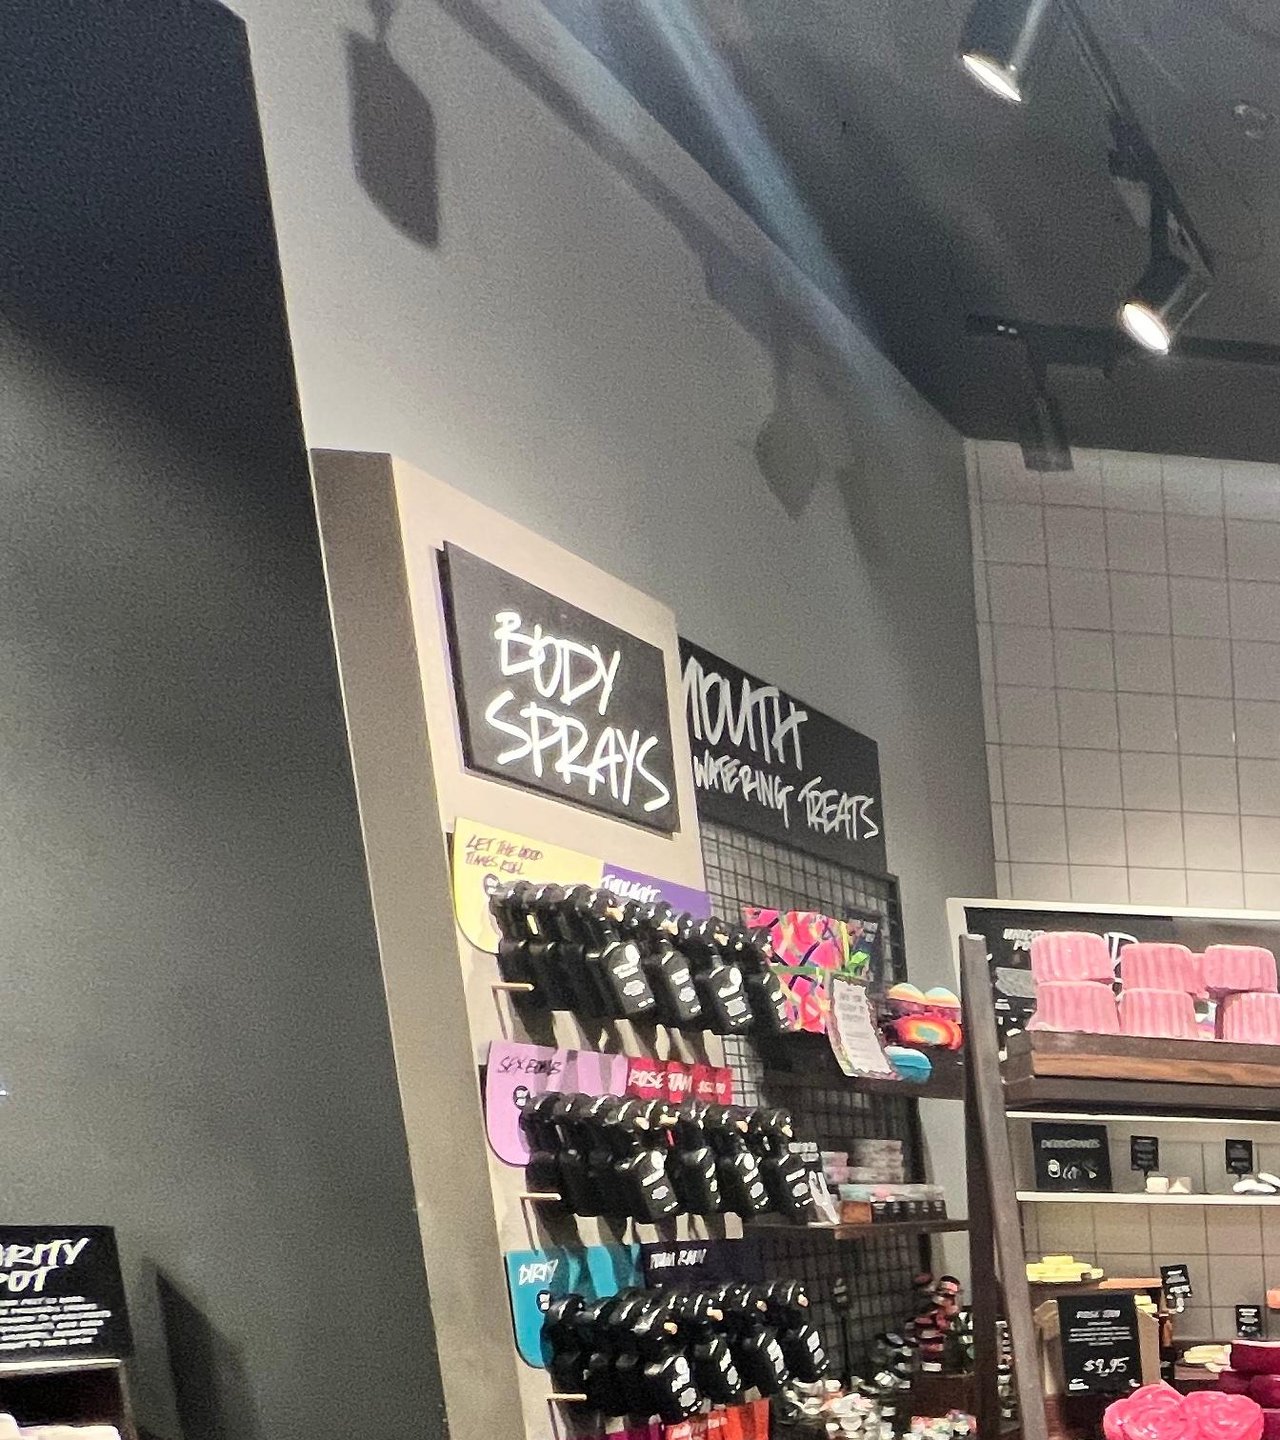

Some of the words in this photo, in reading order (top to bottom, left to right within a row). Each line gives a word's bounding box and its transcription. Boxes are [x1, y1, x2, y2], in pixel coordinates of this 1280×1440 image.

[494, 611, 621, 714] BODY
[485, 690, 671, 812] SPRAYS
[693, 749, 794, 829] WATERING
[798, 775, 879, 842] TREATS
[628, 1069, 664, 1089] ROSE
